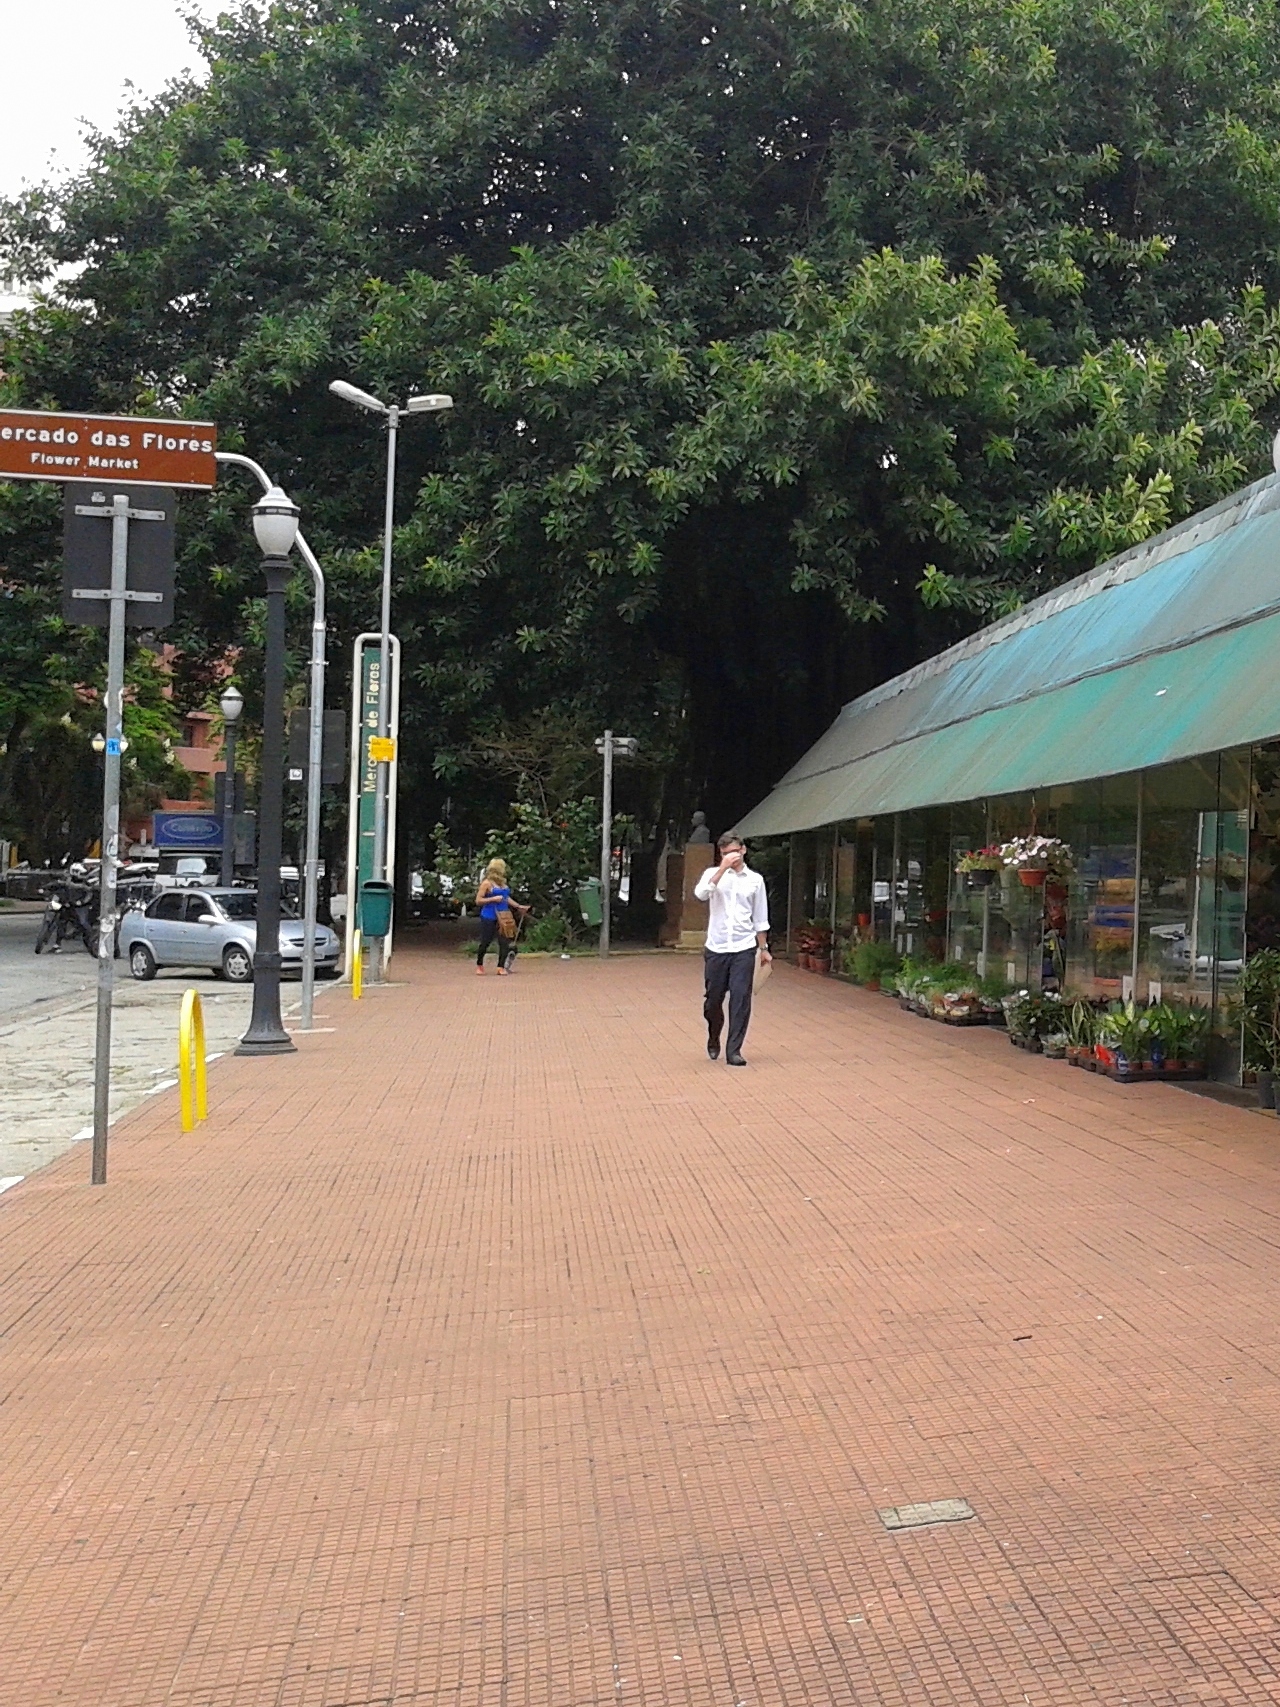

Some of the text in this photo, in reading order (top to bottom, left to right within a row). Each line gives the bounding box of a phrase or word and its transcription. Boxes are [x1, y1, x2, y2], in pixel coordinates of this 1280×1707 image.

[90, 430, 131, 447] das
[142, 432, 213, 453] Flores
[30, 452, 139, 470] Flower Market
[366, 662, 381, 704] Flores
[365, 710, 379, 728] de
